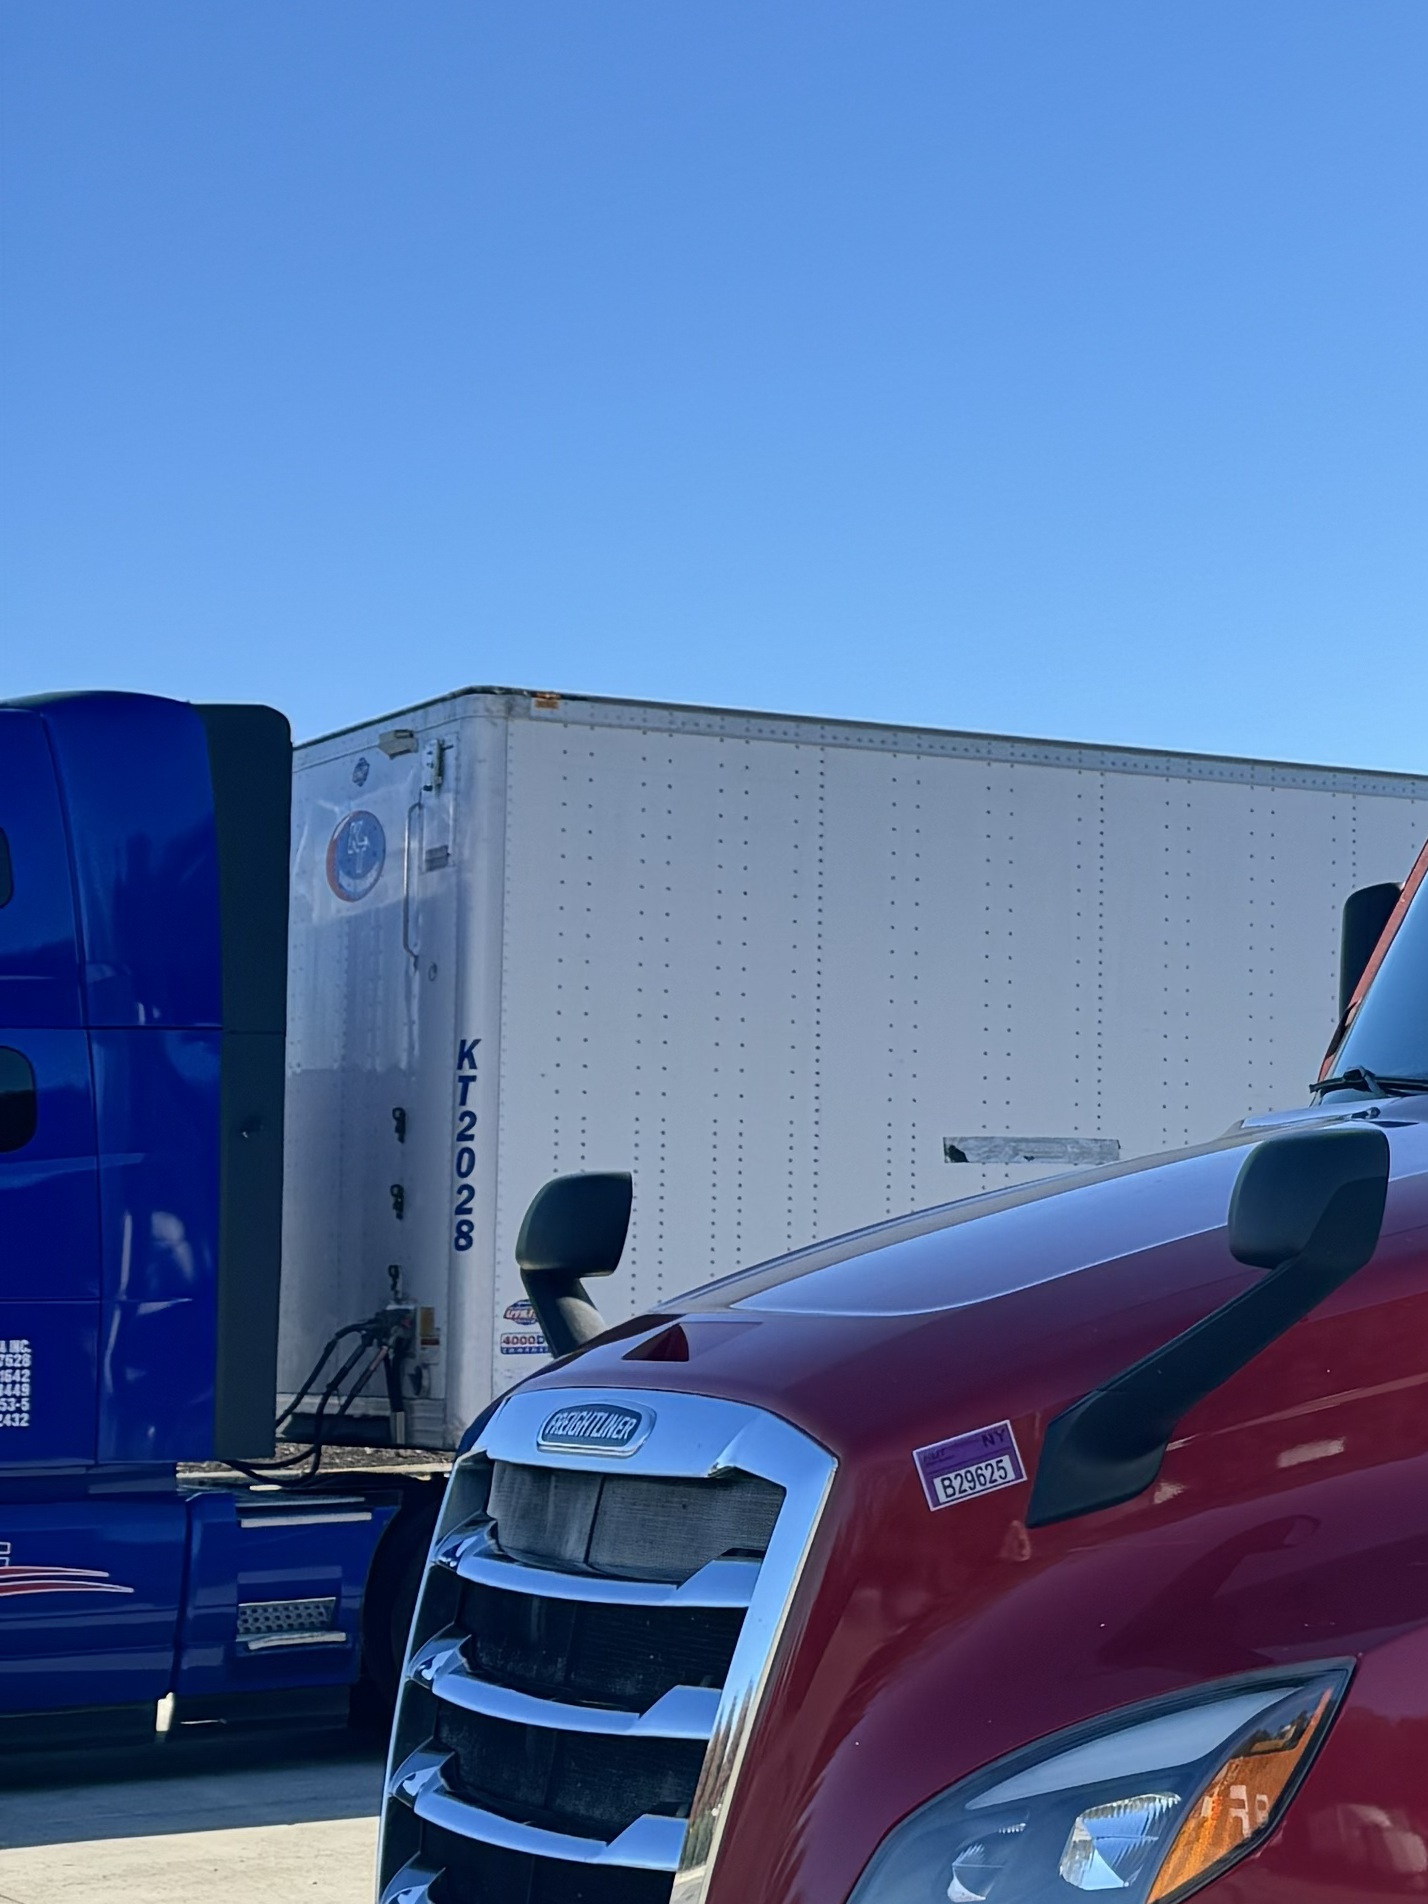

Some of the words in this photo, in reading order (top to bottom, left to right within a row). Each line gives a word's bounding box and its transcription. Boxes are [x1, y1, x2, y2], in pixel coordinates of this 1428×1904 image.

[454, 1038, 482, 1252] KT2028
[544, 1410, 638, 1440] FREIGHTLINER
[980, 1428, 1007, 1447] NY
[940, 1458, 1009, 1499] B29625
